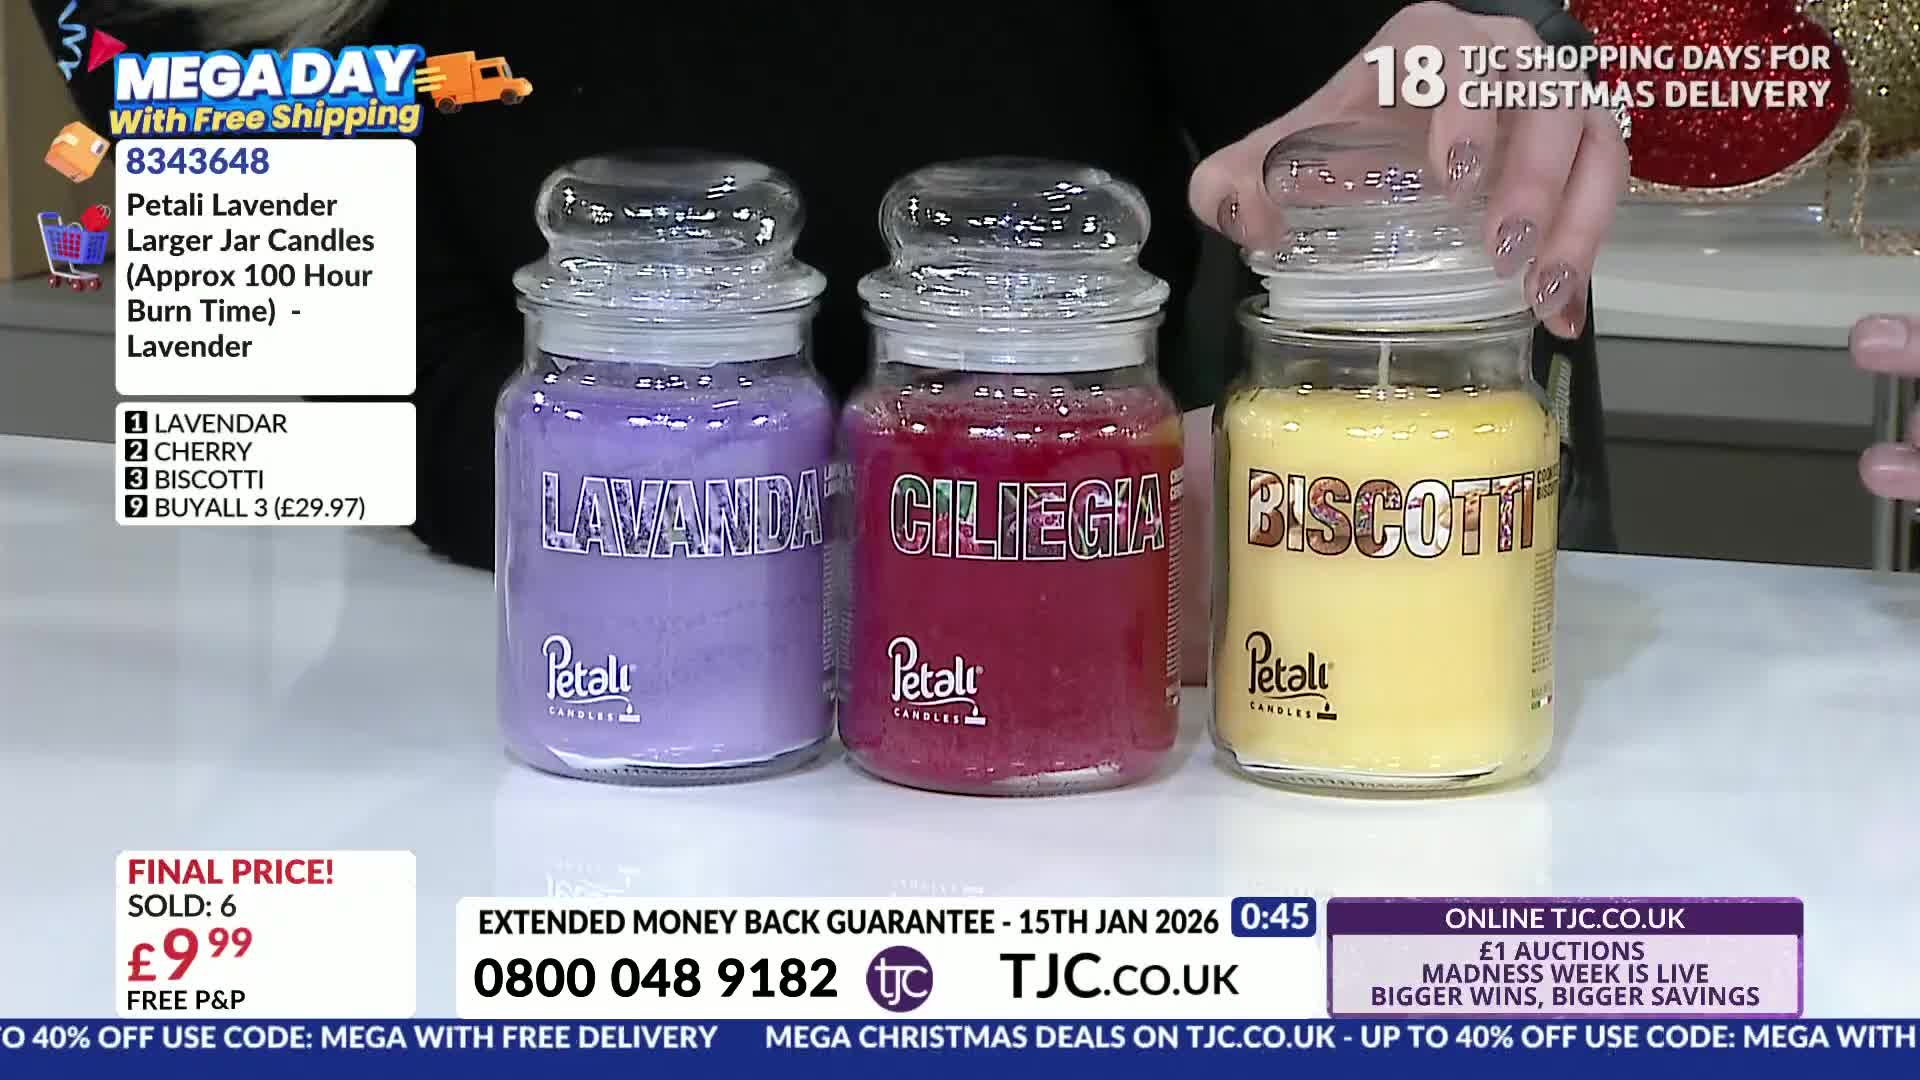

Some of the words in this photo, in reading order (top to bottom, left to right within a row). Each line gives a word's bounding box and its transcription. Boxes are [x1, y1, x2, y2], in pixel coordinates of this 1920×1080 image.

[543, 469, 822, 558] LAVANDA
[890, 473, 1164, 560] CILIEGIA
[1248, 468, 1534, 558] BISCOTTI
[548, 706, 613, 722] CANDLES
[893, 707, 960, 725] CANDLES
[1250, 701, 1311, 719] CANDLES
